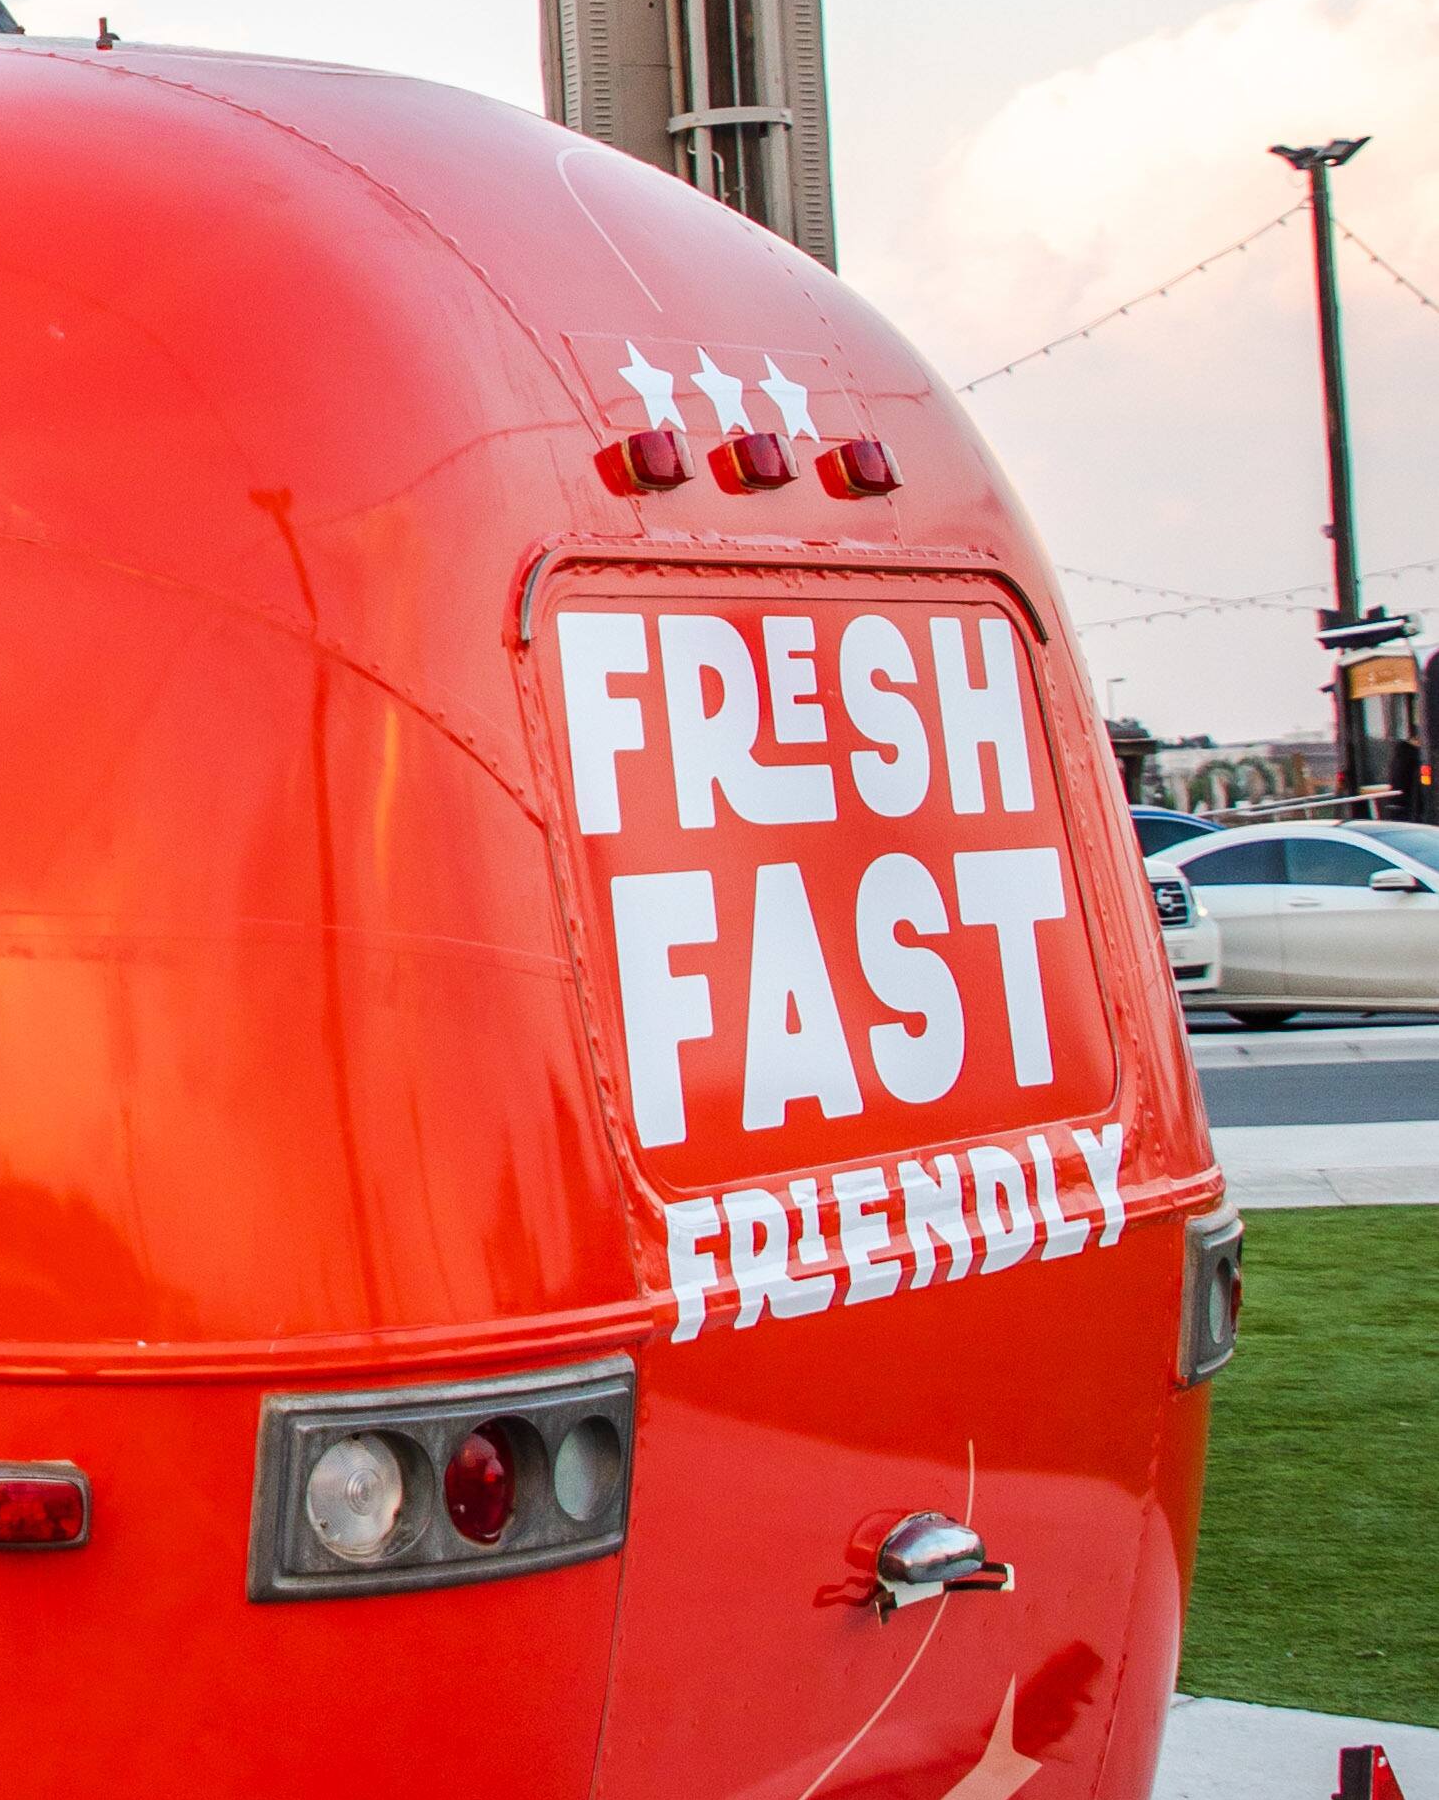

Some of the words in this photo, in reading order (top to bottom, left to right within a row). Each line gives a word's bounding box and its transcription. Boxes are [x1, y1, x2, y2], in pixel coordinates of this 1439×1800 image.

[557, 612, 1036, 835] FRESH
[610, 846, 1066, 1149] FAST
[664, 1121, 1126, 1344] FRIENDLY
